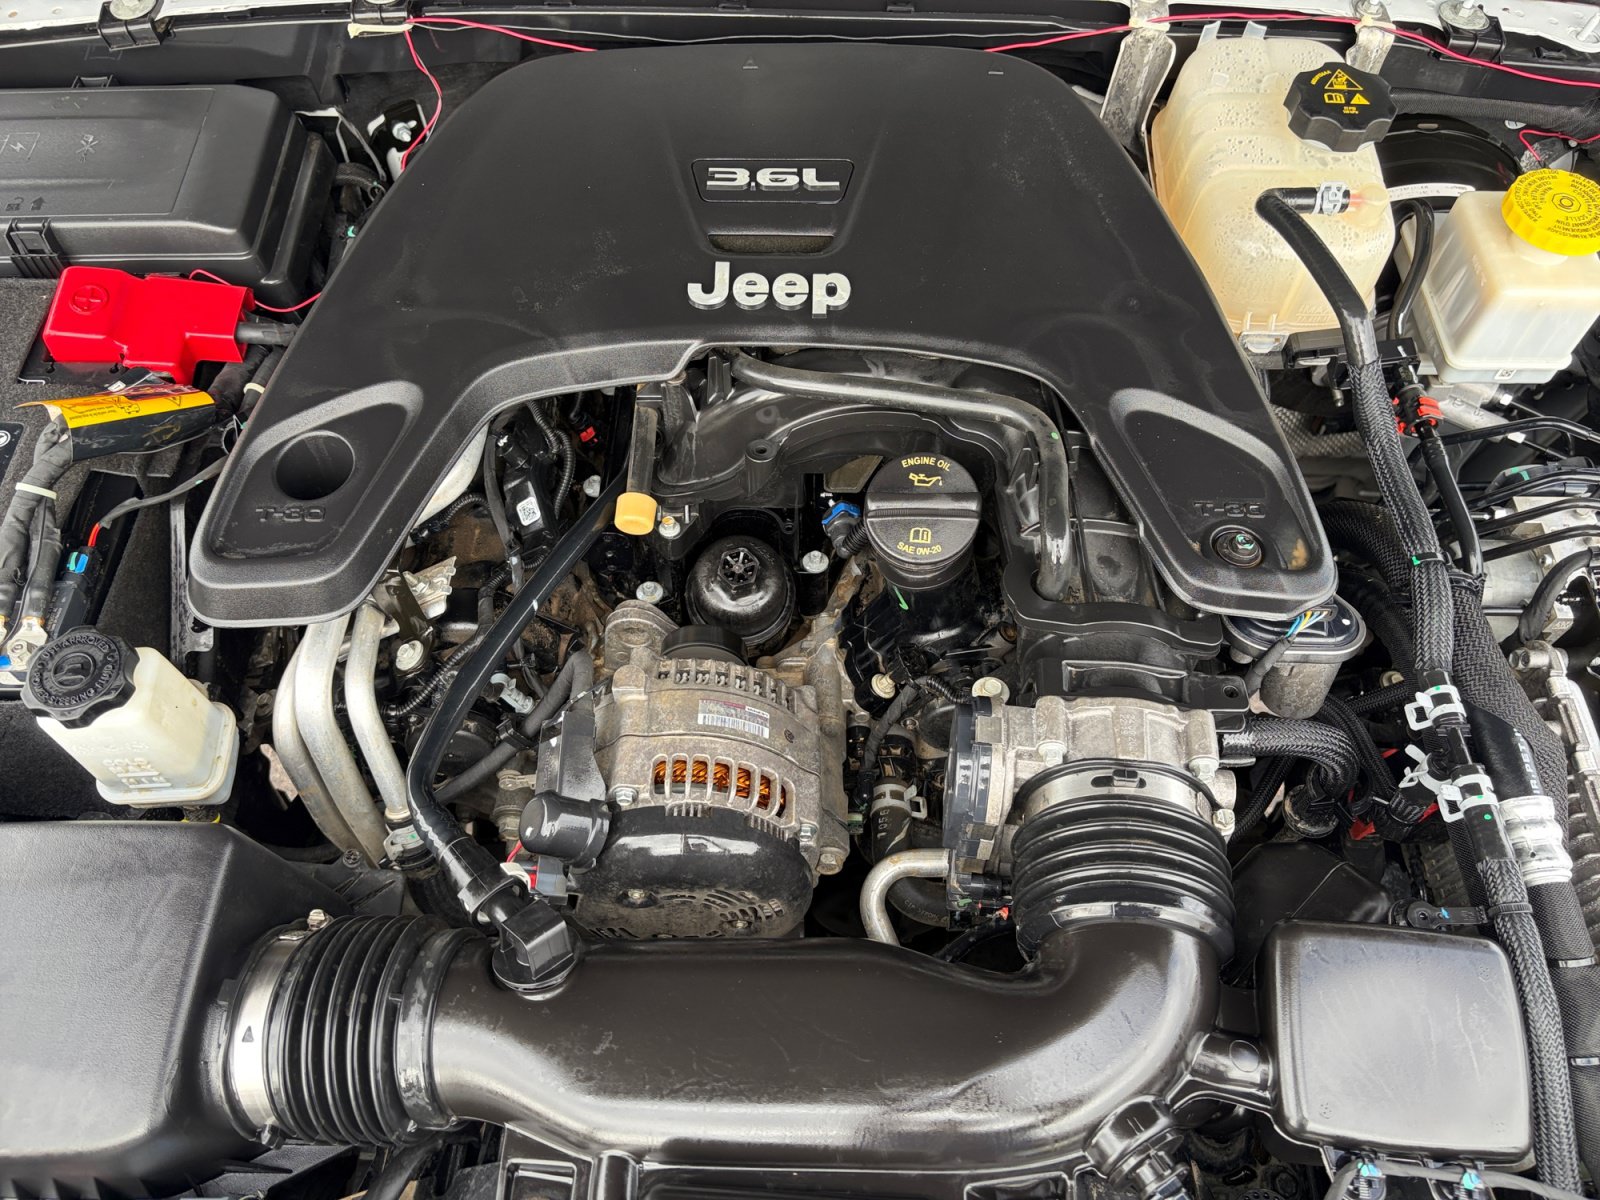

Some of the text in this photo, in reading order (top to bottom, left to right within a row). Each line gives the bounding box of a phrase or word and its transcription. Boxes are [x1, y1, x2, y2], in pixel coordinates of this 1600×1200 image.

[706, 167, 840, 191] 3.6L
[687, 261, 852, 319] Jeep
[901, 456, 952, 472] ENGINE OIL
[896, 541, 942, 555] SAE 0W-20
[62, 634, 111, 653] APPROVED
[49, 687, 96, 707] STEERING
[94, 664, 114, 690] FLUID
